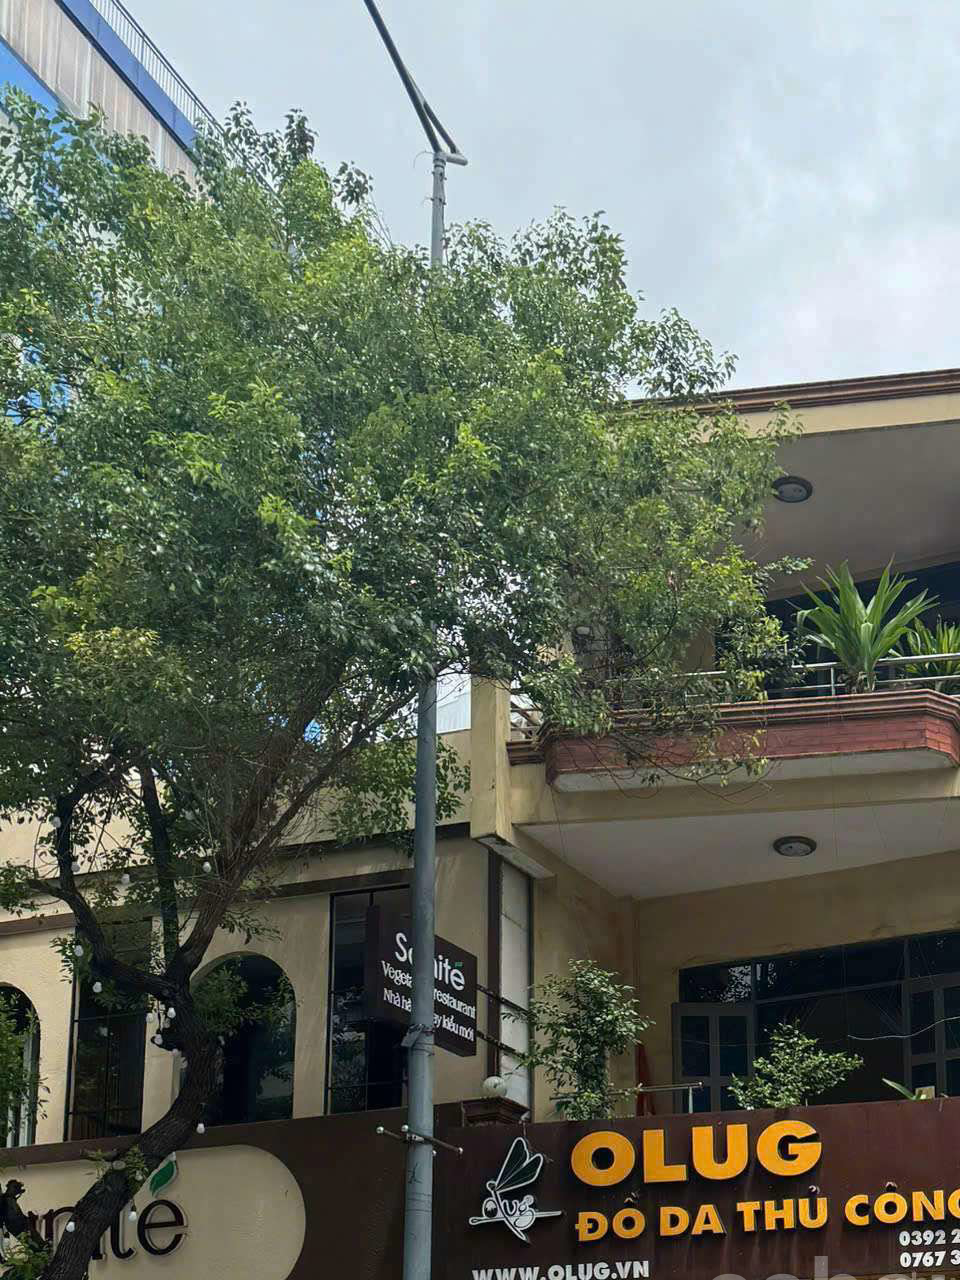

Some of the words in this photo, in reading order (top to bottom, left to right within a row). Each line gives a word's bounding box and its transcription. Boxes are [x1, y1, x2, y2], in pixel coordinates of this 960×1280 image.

[383, 987, 400, 1008] Nhà
[570, 1119, 823, 1187] OLUG
[575, 1192, 646, 1242] ĐỒ
[659, 1203, 727, 1237] DA
[736, 1185, 829, 1233] THỦ
[898, 1229, 947, 1247] 0392
[899, 1250, 947, 1268] 0767
